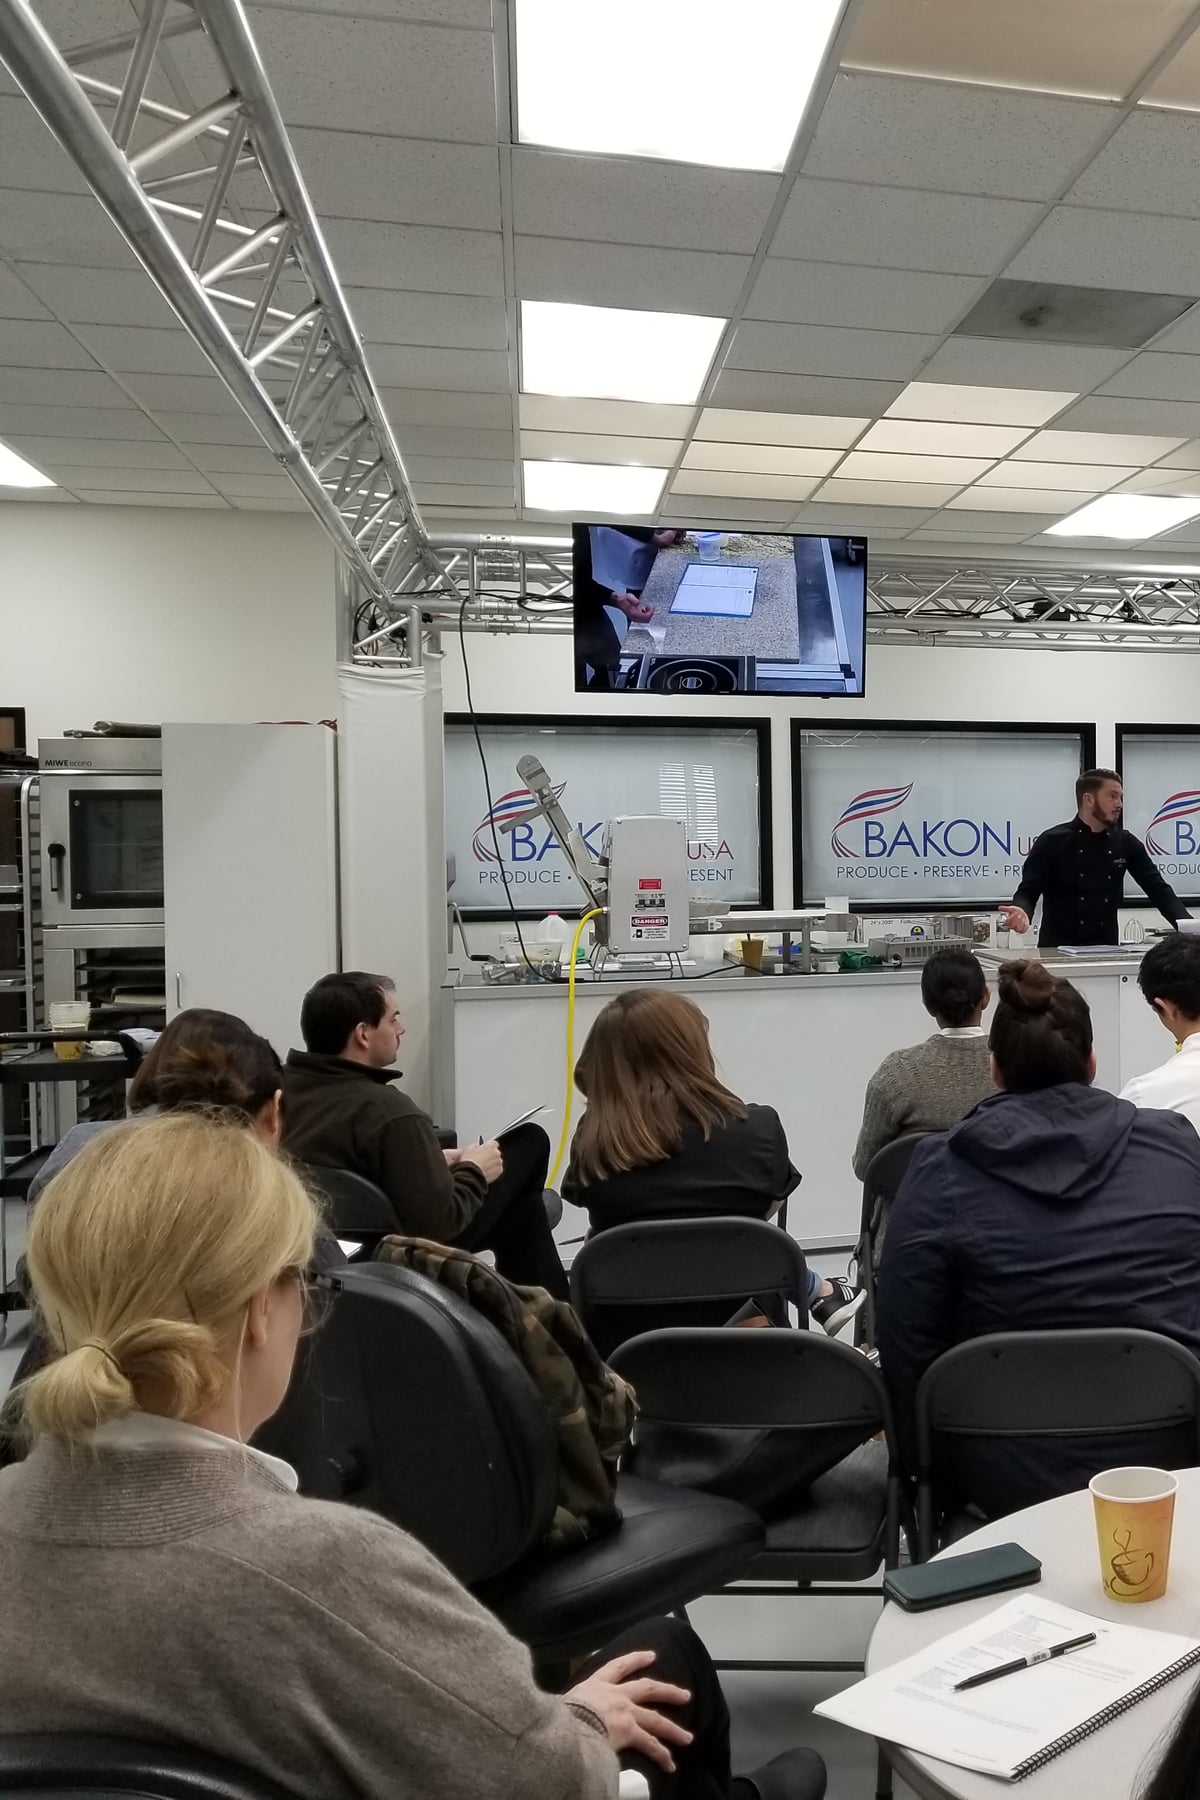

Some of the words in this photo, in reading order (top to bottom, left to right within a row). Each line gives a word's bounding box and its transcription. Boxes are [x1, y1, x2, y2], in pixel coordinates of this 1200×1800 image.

[45, 759, 69, 767] MIWE
[511, 822, 605, 862] BAK
[687, 839, 735, 861] USA
[864, 819, 1011, 858] BAKON
[479, 869, 561, 884] PRODUCE
[687, 868, 734, 882] ESENT
[836, 865, 909, 879] PRODUCE
[923, 865, 990, 878] PRESERVE
